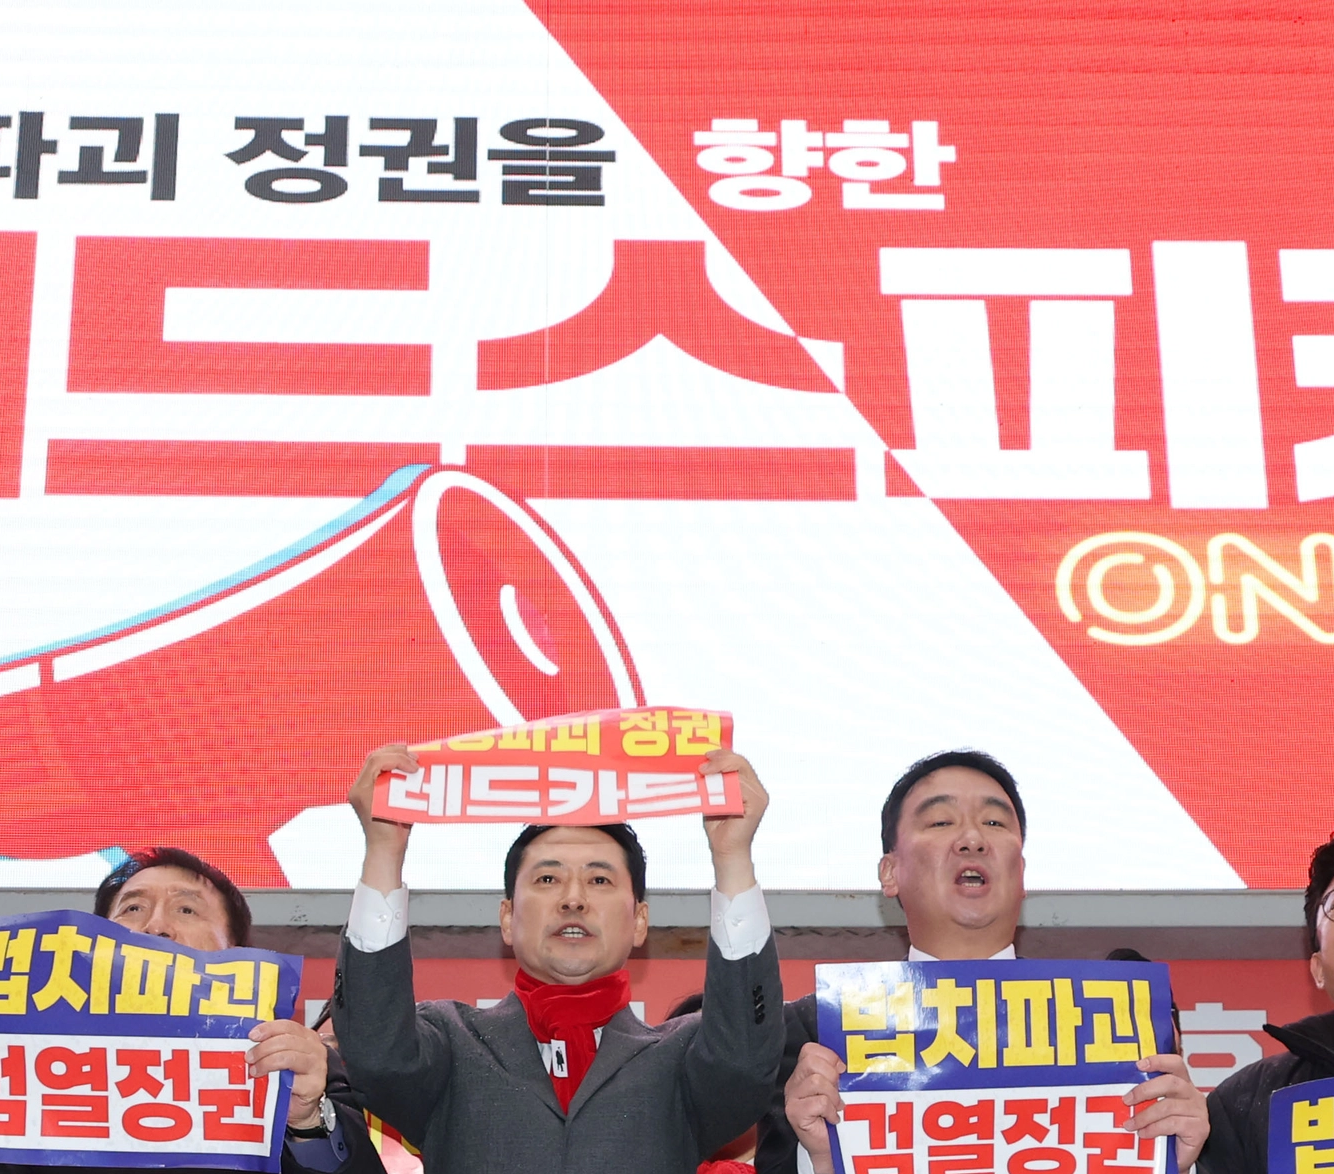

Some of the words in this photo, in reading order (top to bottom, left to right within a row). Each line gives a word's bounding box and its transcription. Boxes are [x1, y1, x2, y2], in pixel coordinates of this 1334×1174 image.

[225, 117, 616, 208] 정권을
[693, 118, 956, 212] 향한
[407, 714, 600, 755] 파괴
[620, 711, 723, 757] 정권
[387, 764, 727, 817] 레드카드!
[841, 976, 1157, 1074] 법치파괴
